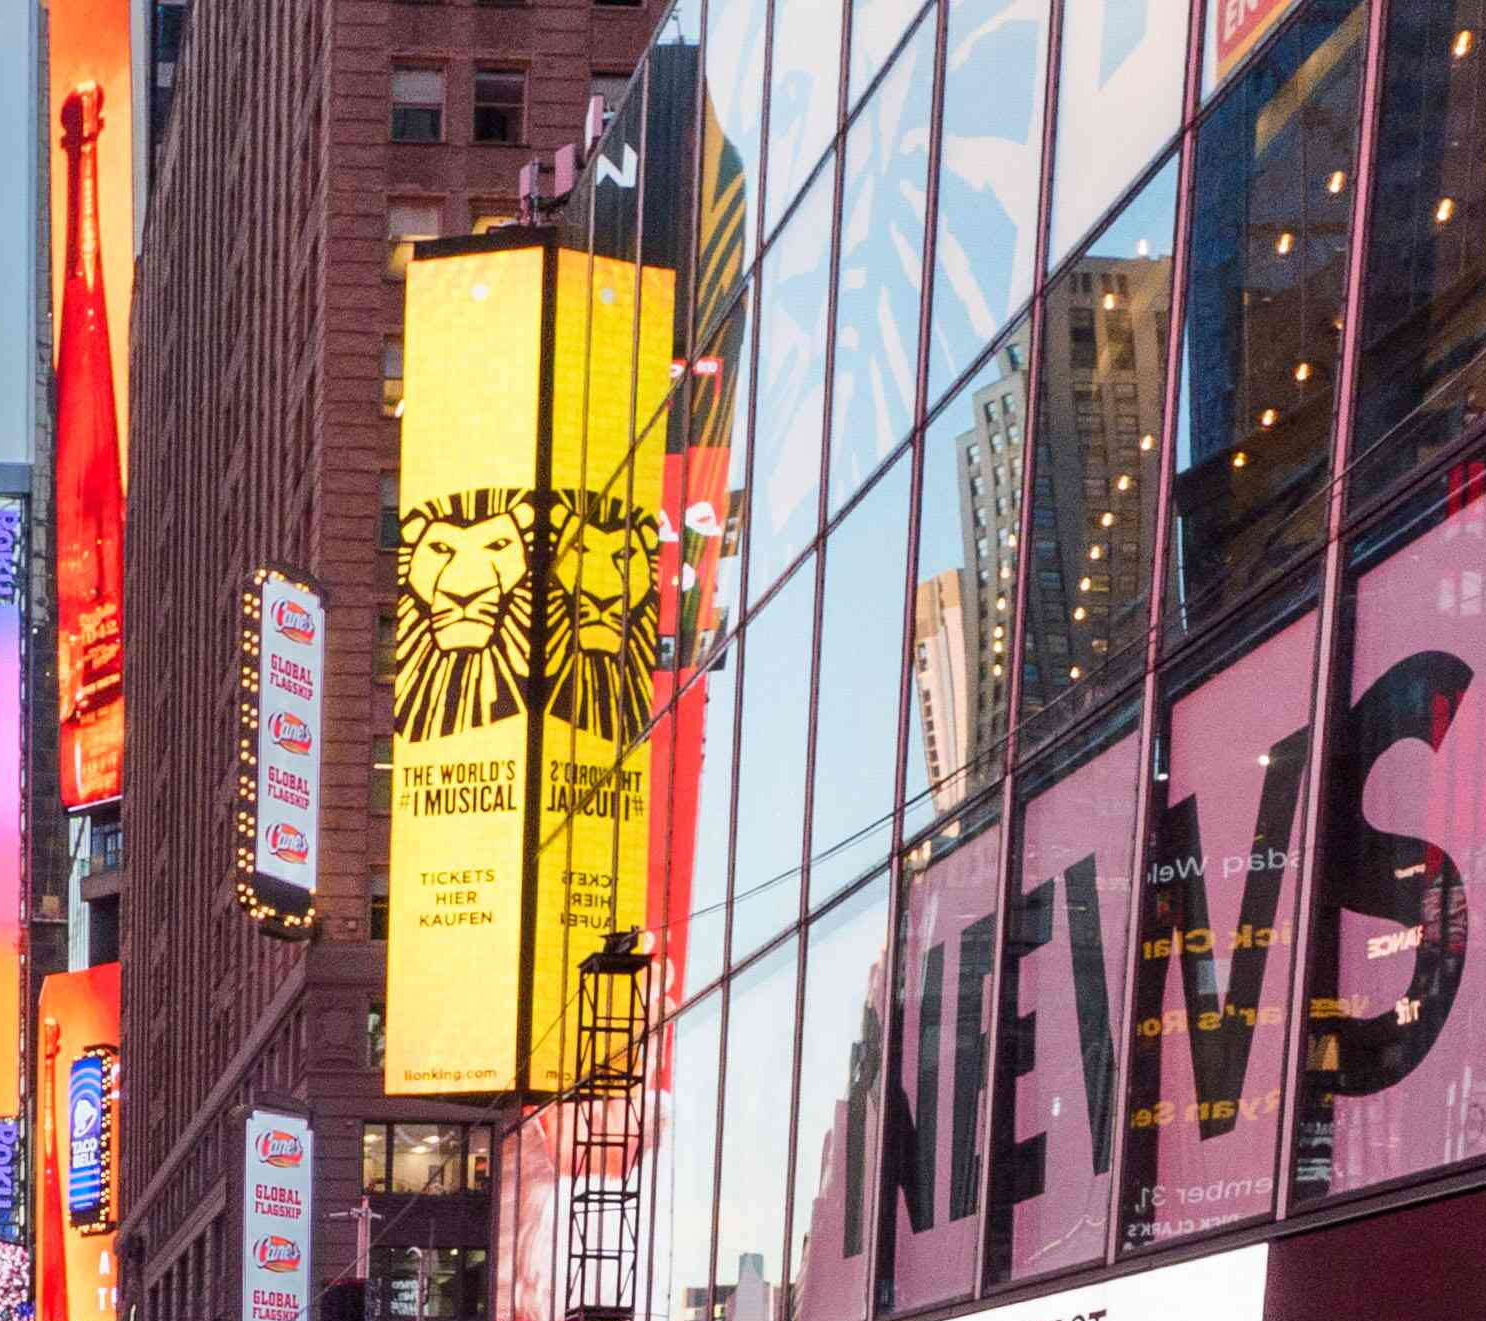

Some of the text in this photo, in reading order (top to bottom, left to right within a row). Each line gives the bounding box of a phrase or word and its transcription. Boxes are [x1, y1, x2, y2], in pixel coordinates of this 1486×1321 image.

[271, 654, 313, 686] GLOBAL
[270, 672, 313, 701] FLAGSHIP
[268, 766, 310, 796] GLOBAL
[403, 760, 516, 787] THE WORLD'S
[268, 783, 310, 811] FLAGSHIP
[425, 786, 517, 816] MUSICAL
[421, 869, 496, 886] TICKETS
[436, 891, 477, 905] HIER
[419, 911, 493, 928] KAUFEN
[404, 1068, 496, 1083] lionking.com
[71, 1140, 97, 1153] TACO
[72, 1151, 97, 1167] BELL
[255, 1184, 301, 1204] GLOBAL
[255, 1201, 301, 1219] FLAGSHIP
[253, 1289, 299, 1309] GLOBAL
